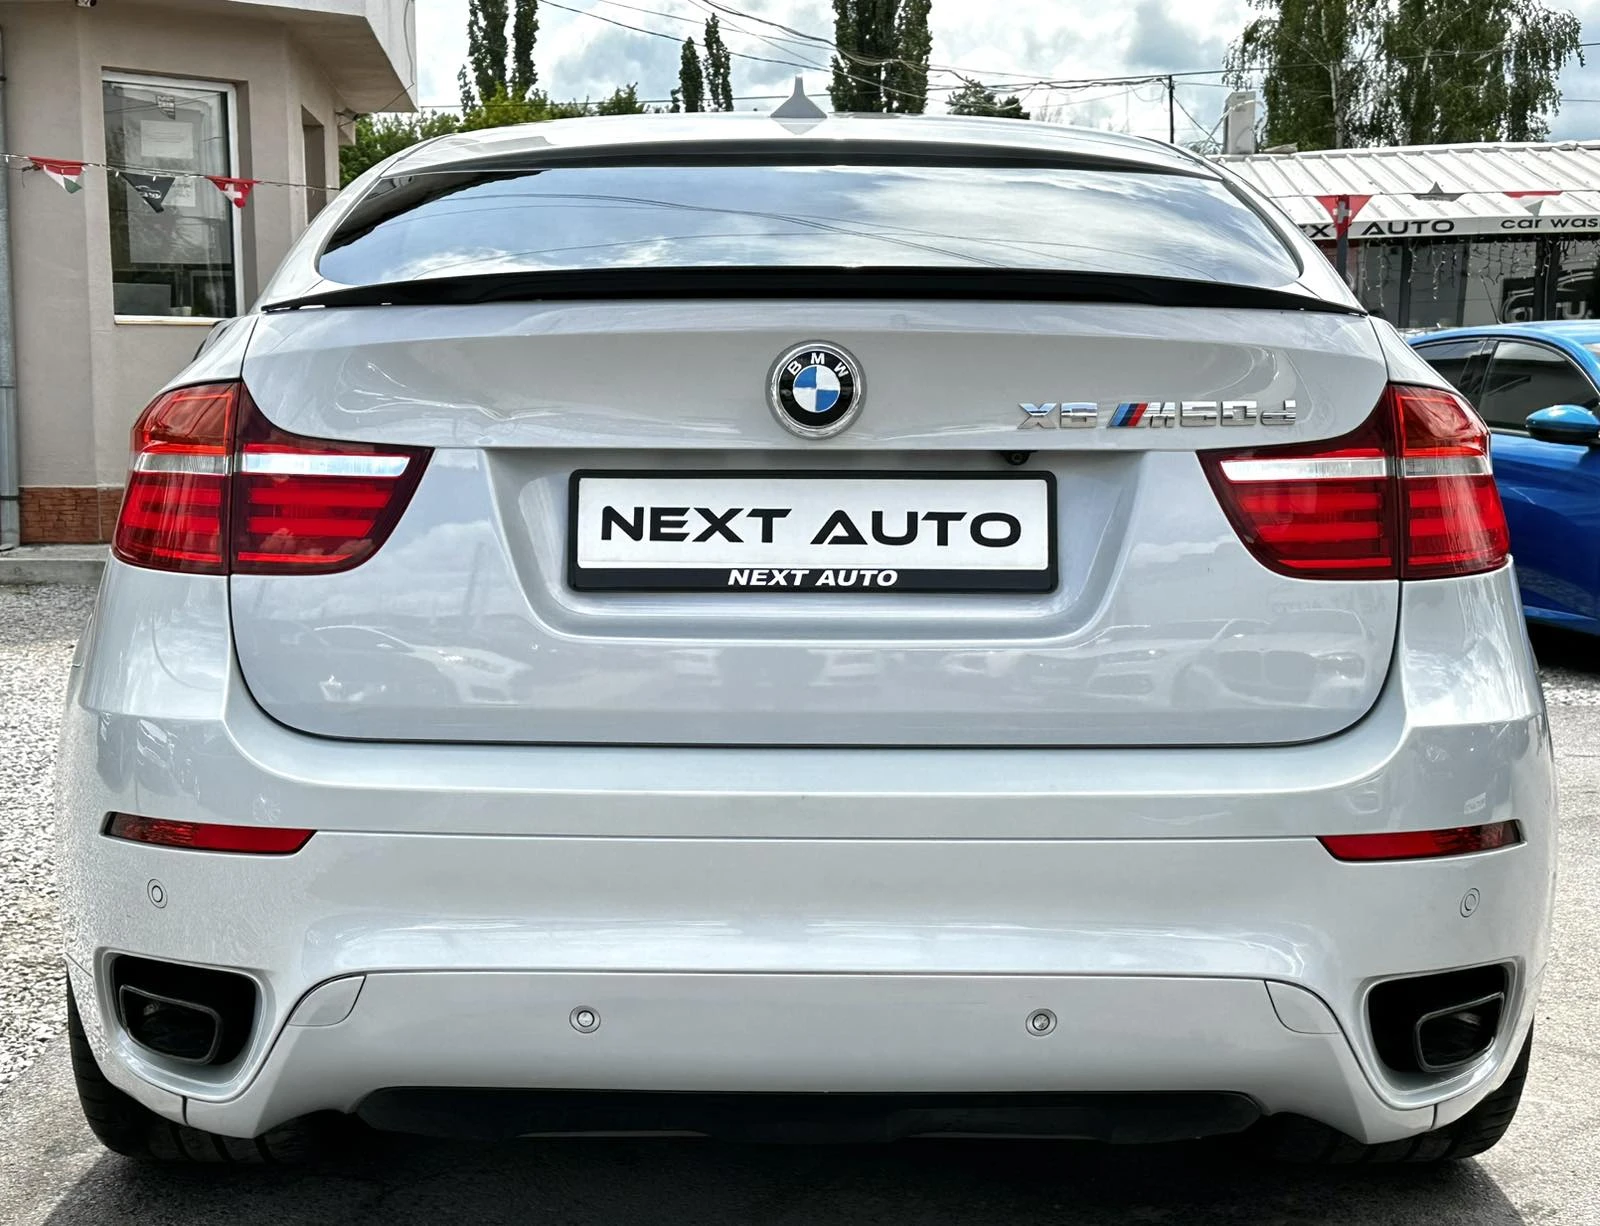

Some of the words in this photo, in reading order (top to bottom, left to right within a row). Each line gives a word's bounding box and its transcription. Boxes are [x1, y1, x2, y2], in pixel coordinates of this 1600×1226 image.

[1361, 219, 1455, 236] AUTO
[1500, 218, 1543, 230] car
[1550, 217, 1600, 229] was
[787, 352, 849, 377] BMW
[1017, 402, 1098, 429] X6
[601, 505, 792, 544] NEXT
[809, 509, 1022, 548] AUTO
[727, 569, 810, 587] NEXT
[814, 569, 899, 587] AUTO
